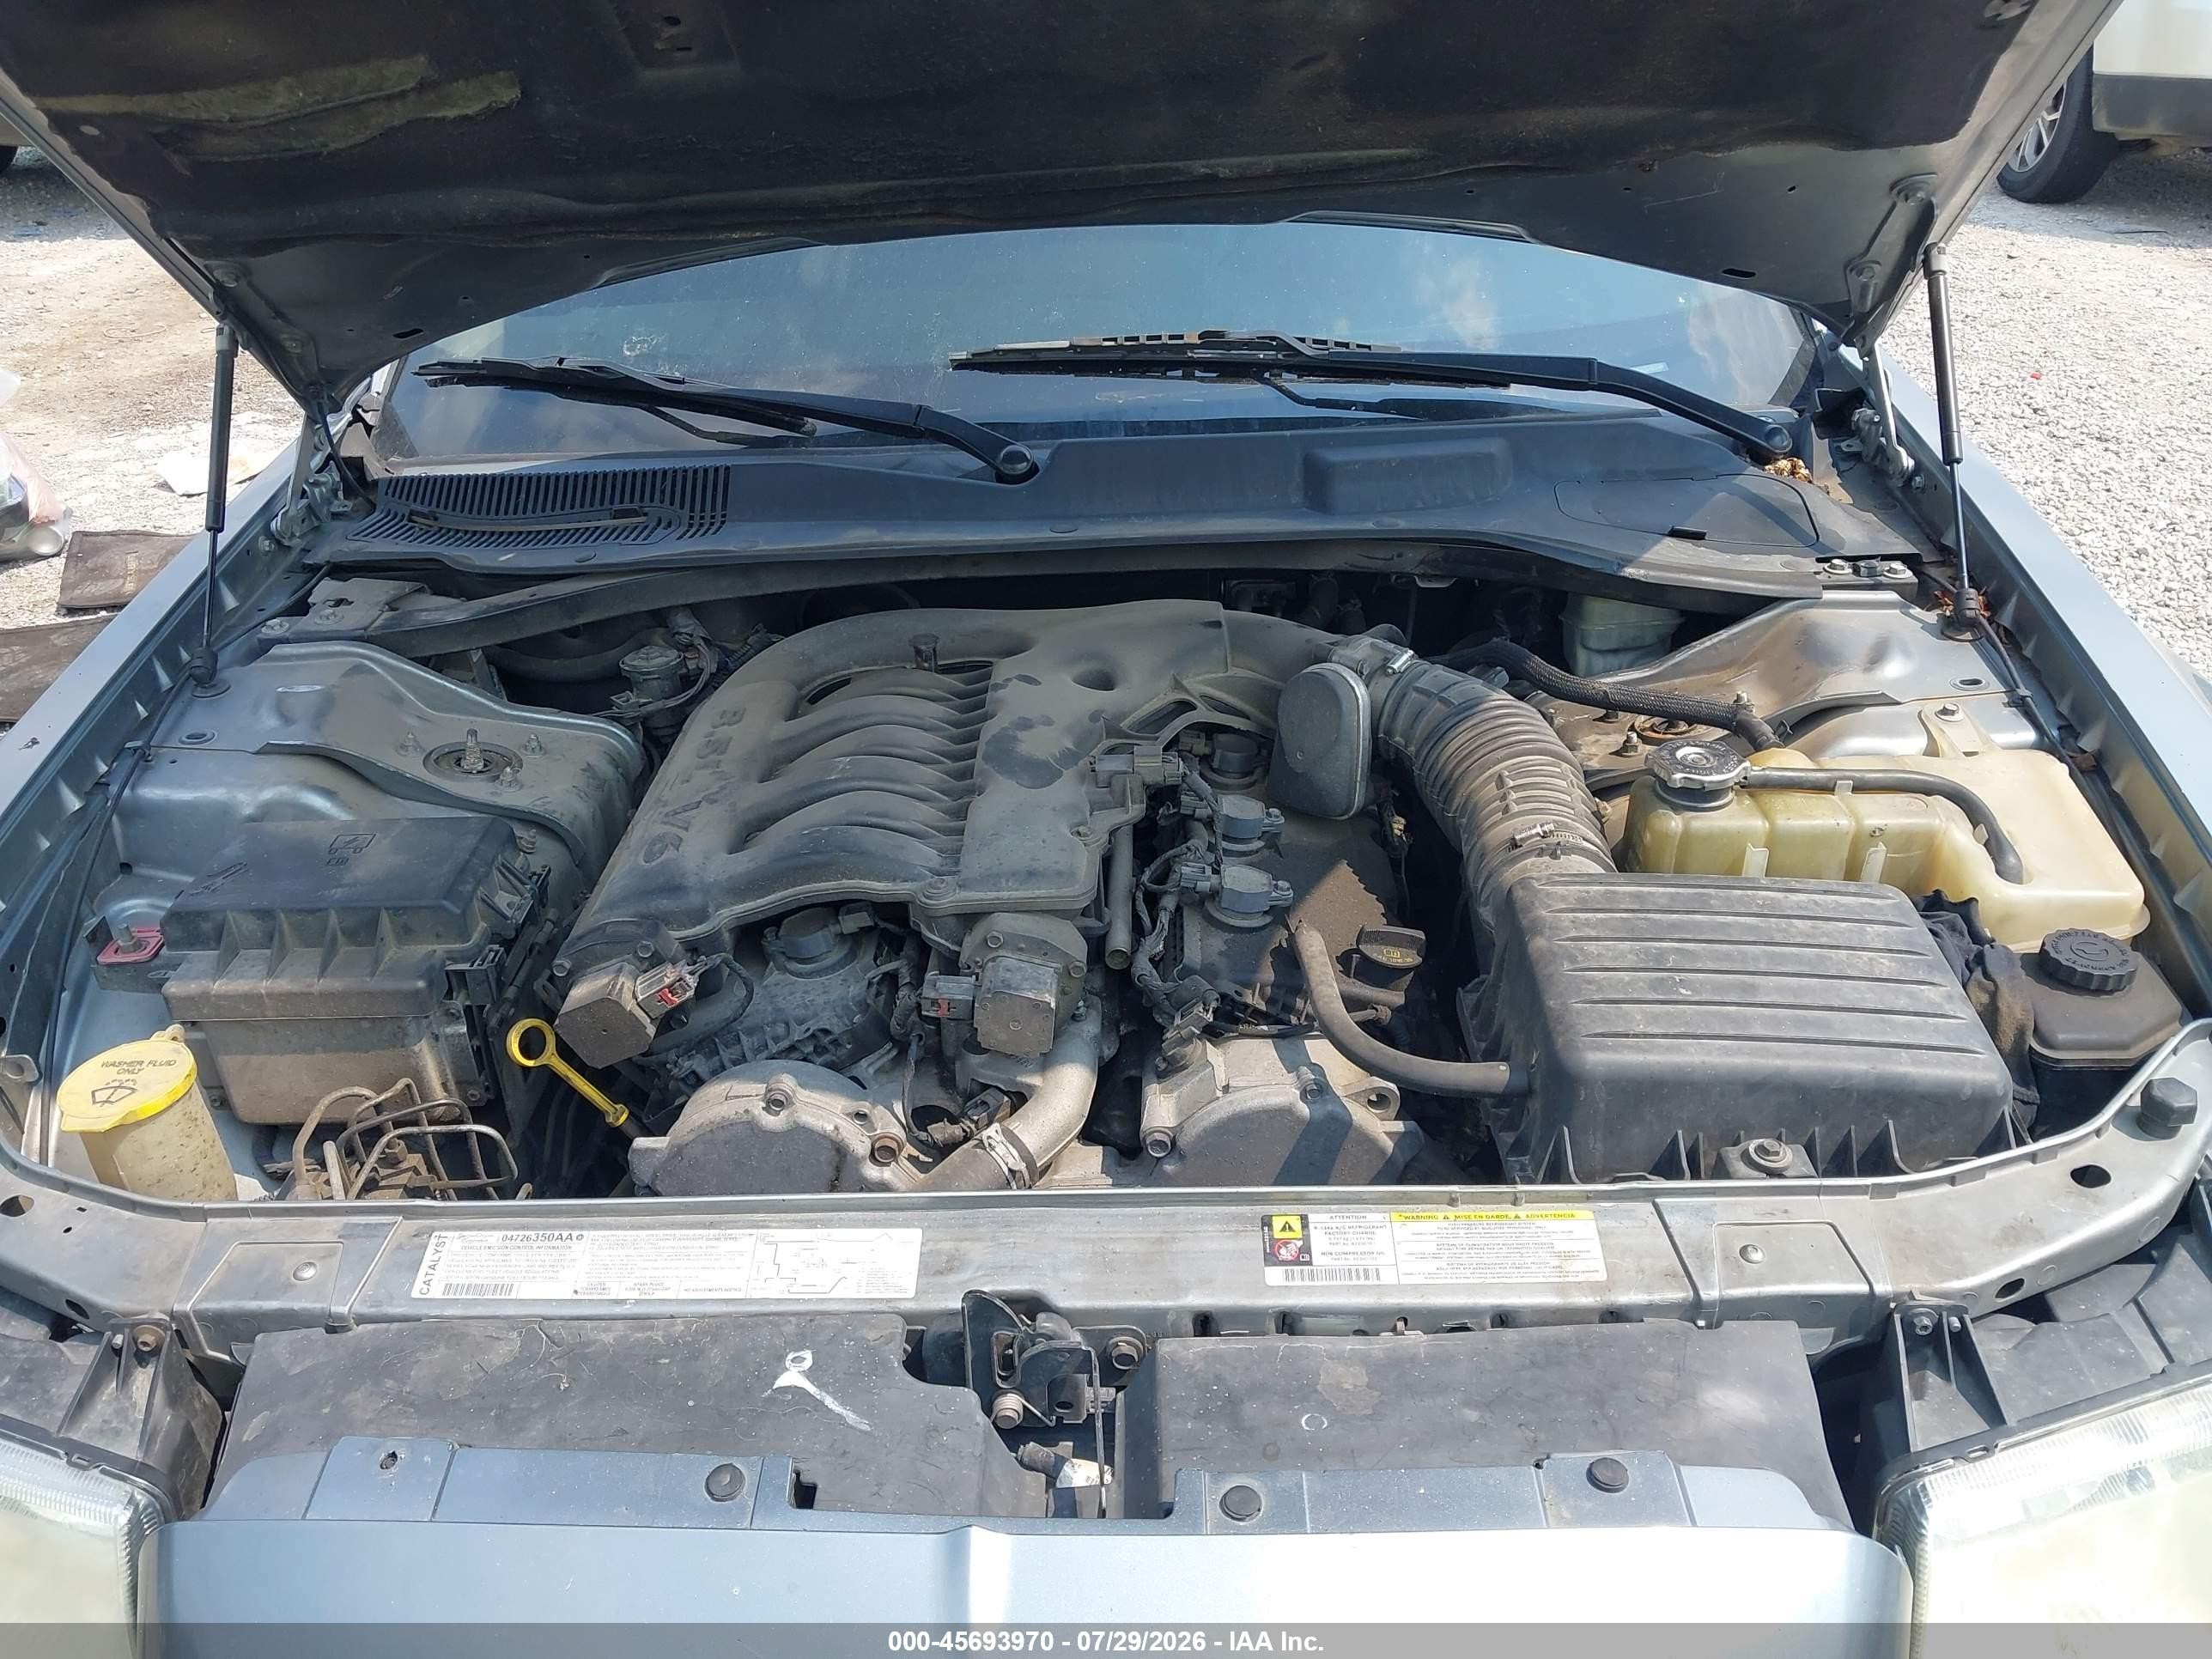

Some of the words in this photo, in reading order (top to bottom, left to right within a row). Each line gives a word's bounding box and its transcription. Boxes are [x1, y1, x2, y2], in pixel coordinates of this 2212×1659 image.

[101, 1060, 144, 1068] WASHER
[147, 1059, 177, 1067] FLUID
[501, 1232, 574, 1243] 04726350AA
[418, 1233, 448, 1296] CATALYST
